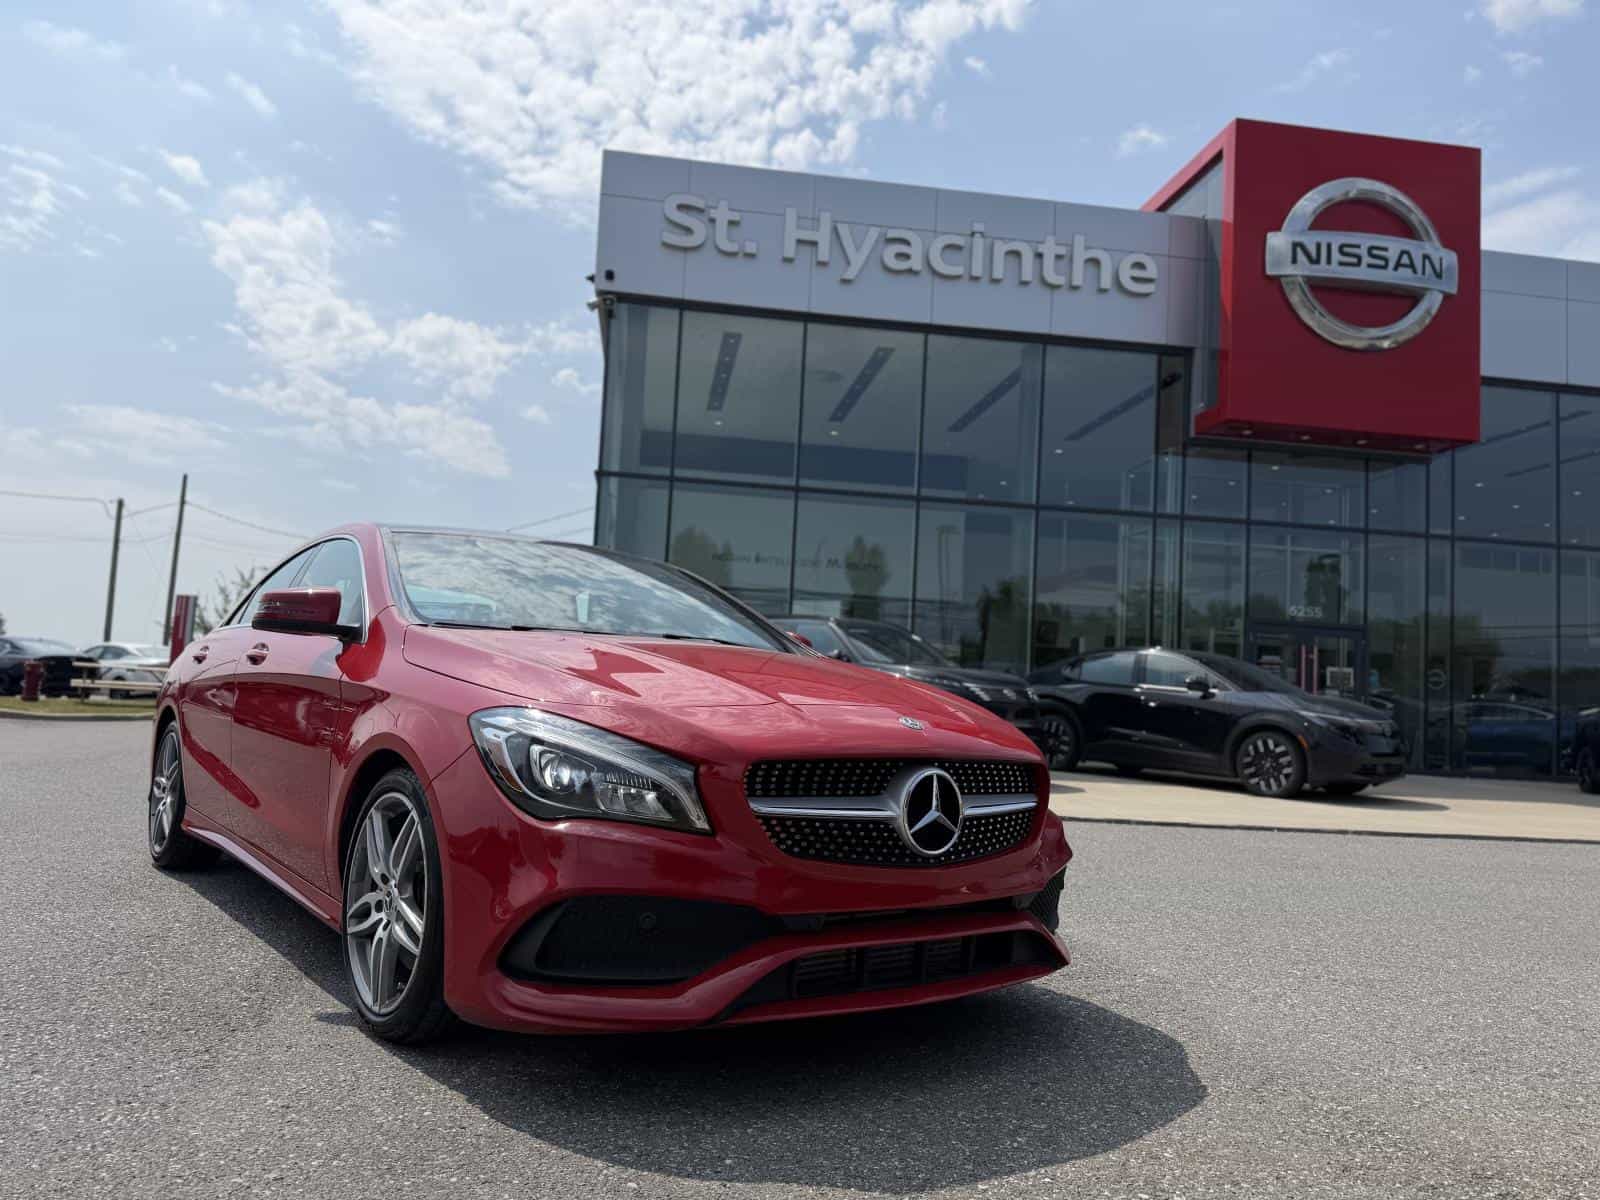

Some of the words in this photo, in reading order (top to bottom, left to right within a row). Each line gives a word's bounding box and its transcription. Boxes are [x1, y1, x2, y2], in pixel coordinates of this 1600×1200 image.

[661, 193, 758, 257] St.
[782, 207, 1160, 295] Hyacinthe
[1291, 241, 1443, 280] NISSAN
[1288, 605, 1323, 618] 6255
